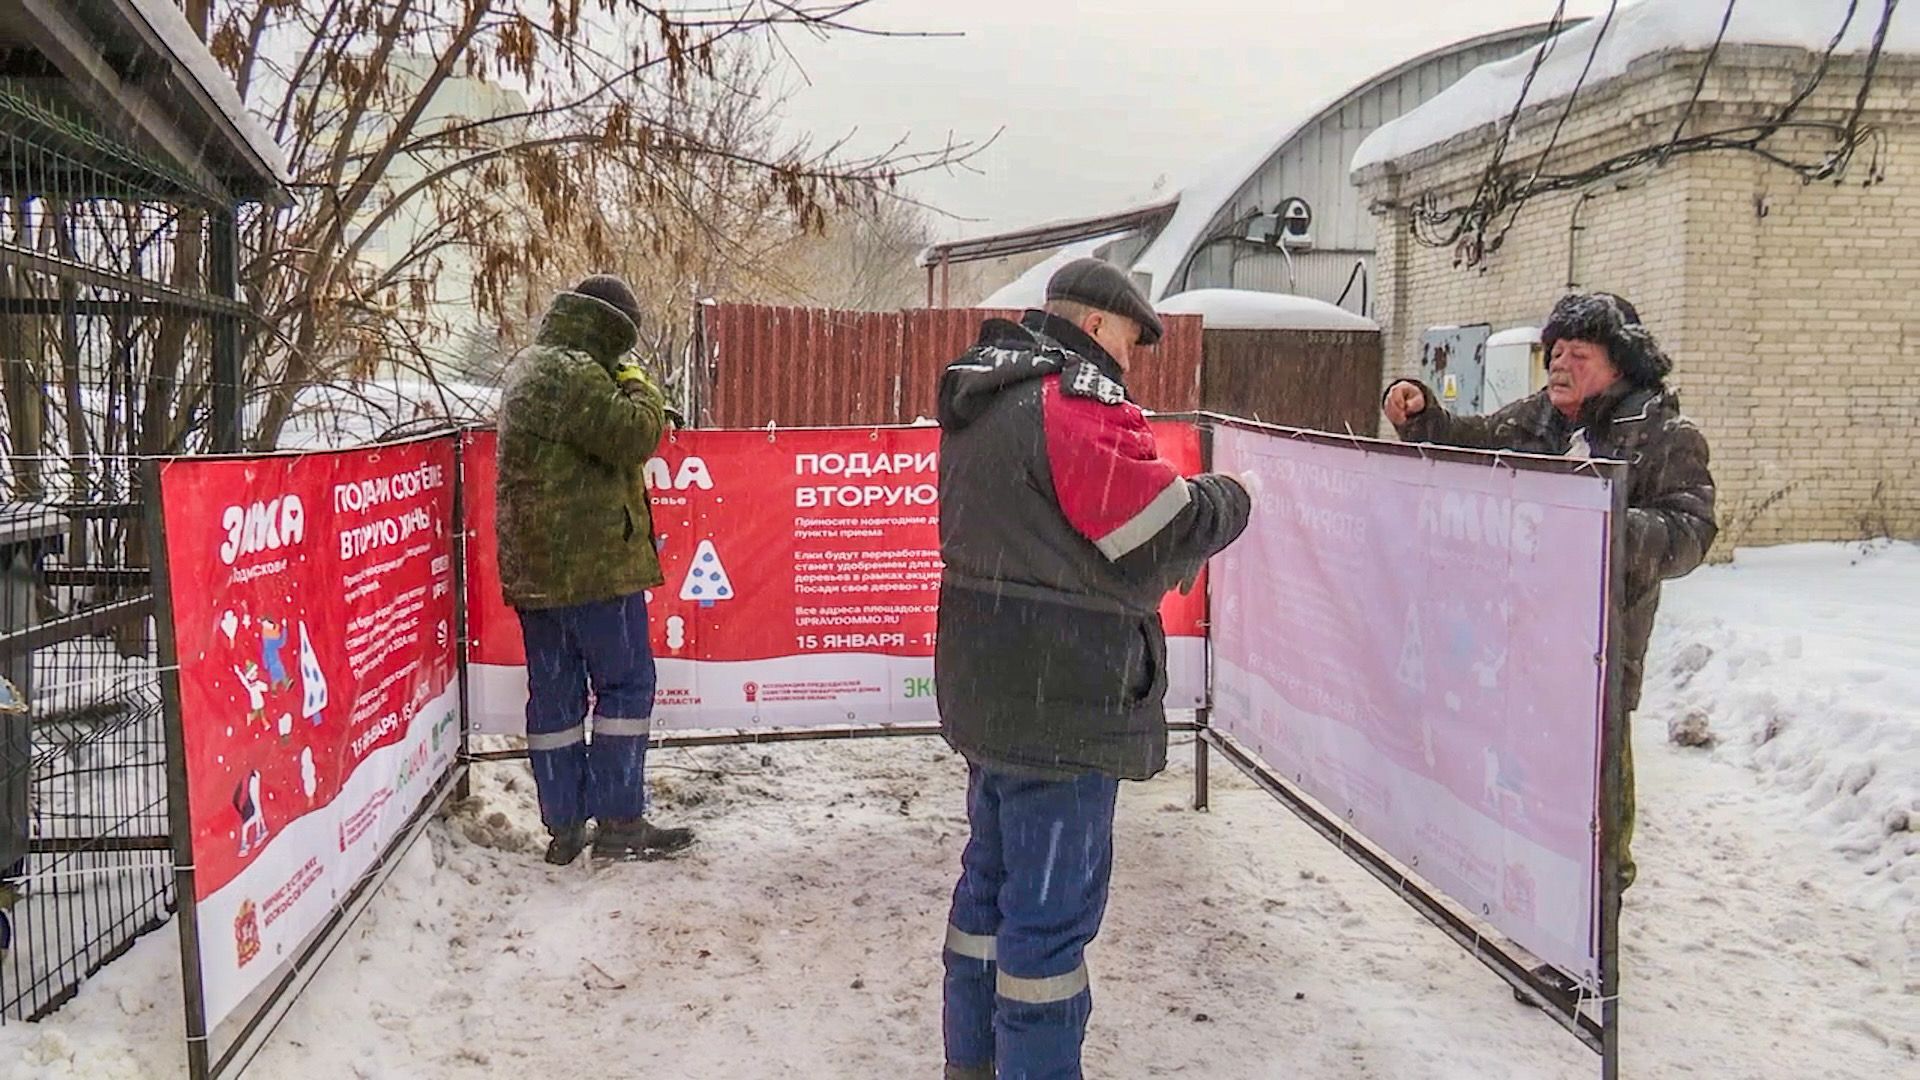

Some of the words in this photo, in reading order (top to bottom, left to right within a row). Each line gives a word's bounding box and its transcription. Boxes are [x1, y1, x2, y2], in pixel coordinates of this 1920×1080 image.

[795, 452, 937, 478] ПОДАРИ
[795, 484, 939, 507] ВТОРУЮ
[794, 516, 859, 527] Приносите
[794, 529, 838, 539] пункты
[825, 550, 859, 561] будут
[794, 562, 834, 571] станет
[837, 560, 907, 572] удобрением
[908, 559, 930, 570] для
[861, 572, 904, 583] рамках
[794, 584, 840, 594] Посади
[841, 583, 870, 592] свое
[795, 606, 817, 616] Все
[819, 606, 862, 617] адреса
[862, 605, 922, 616] площадок
[795, 615, 900, 627] UPRAVDOMMO.RU
[796, 635, 818, 649] 15
[822, 633, 905, 648] ЯНВАРЯ
